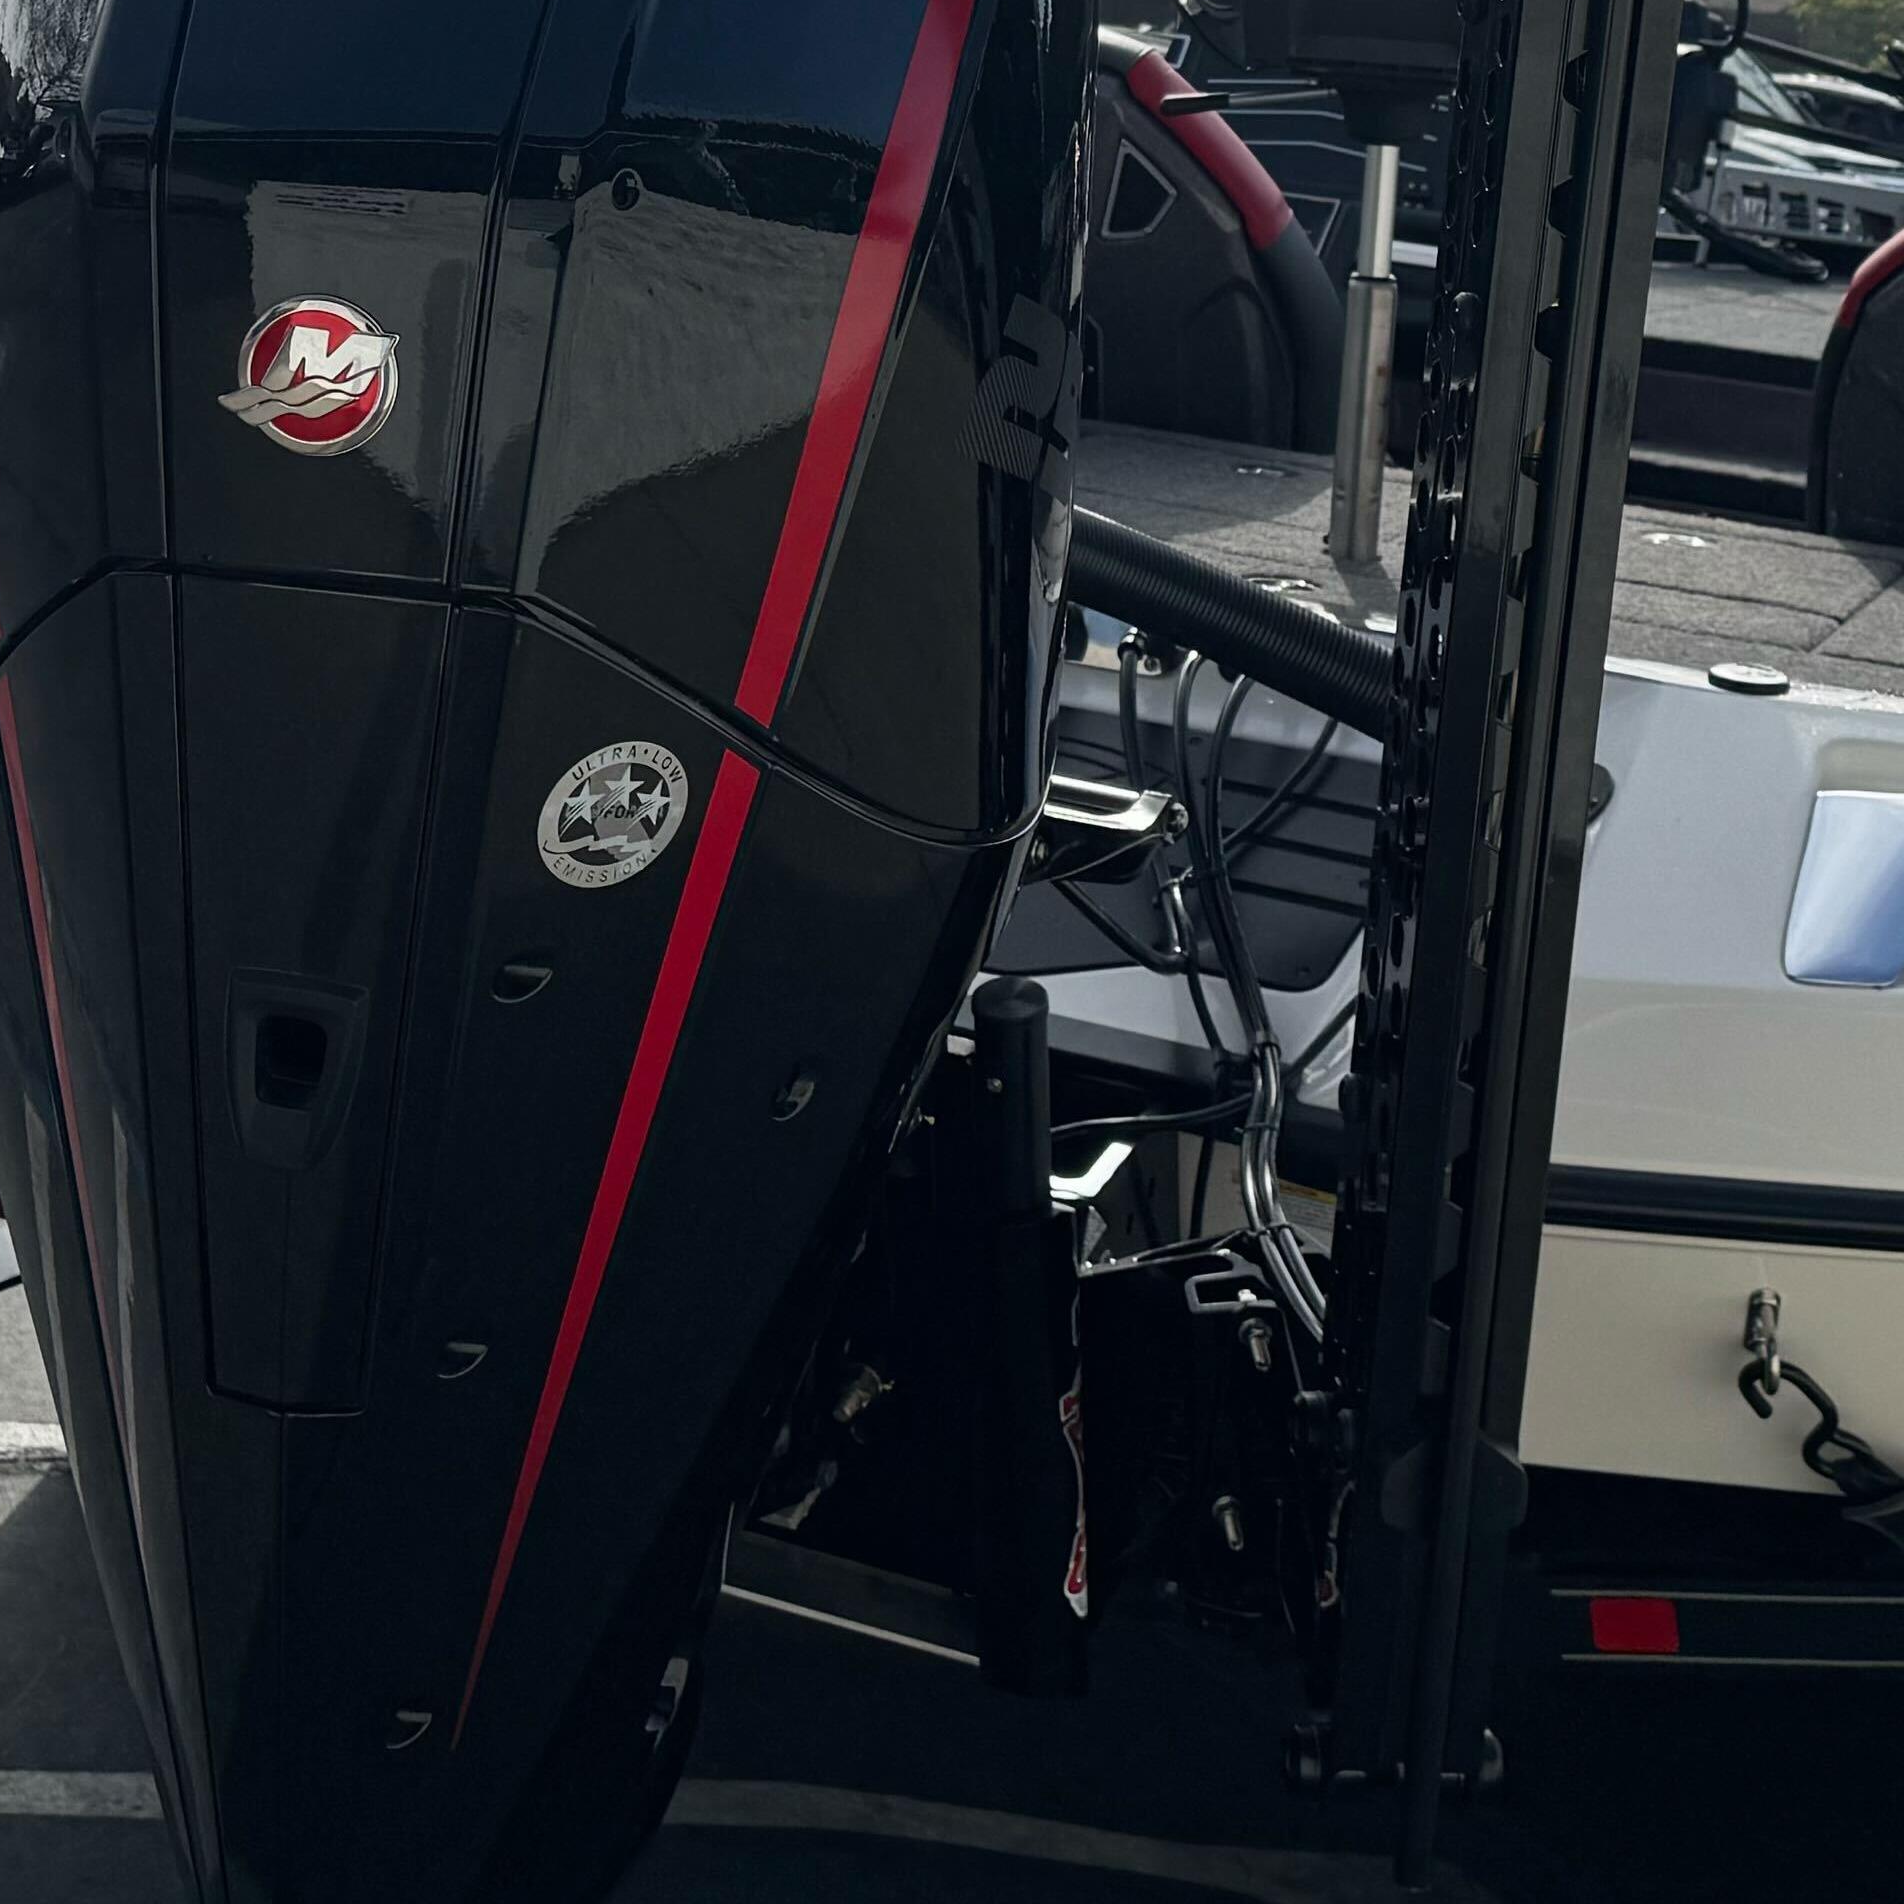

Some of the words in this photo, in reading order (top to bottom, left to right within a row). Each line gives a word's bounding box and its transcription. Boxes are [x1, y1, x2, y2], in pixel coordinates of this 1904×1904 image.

[571, 744, 638, 782] ULTRA
[651, 749, 684, 783] LOW
[553, 854, 647, 884] EMISSION
